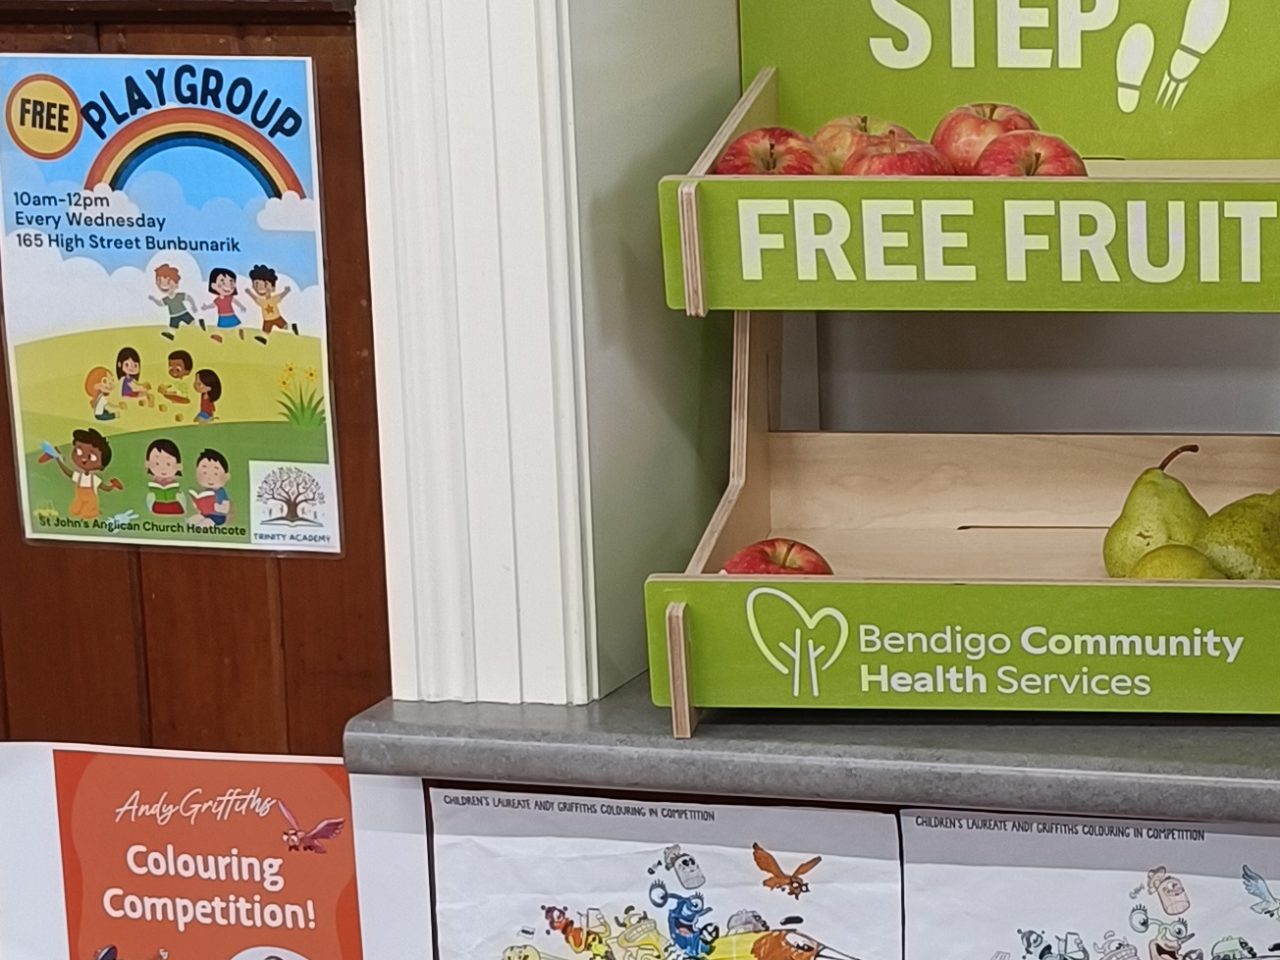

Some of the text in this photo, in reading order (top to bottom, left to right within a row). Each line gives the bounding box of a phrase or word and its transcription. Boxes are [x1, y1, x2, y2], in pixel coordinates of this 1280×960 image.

[19, 98, 70, 133] FREE
[79, 64, 302, 140] PLAYGROUP
[13, 191, 110, 211] 10am-12pm
[15, 211, 166, 232] Every Wednesday
[17, 233, 241, 252] 165 High Street Bunbunarik
[737, 199, 1279, 284] FREE FRUIT
[39, 516, 246, 536] St John's Anglican Church Heathcote
[254, 533, 331, 543] TRINITY ACADEMY
[858, 624, 1245, 663] Bendigo Community
[860, 664, 1152, 697] Health Services
[115, 787, 277, 825] Andy Griffiths
[443, 794, 489, 807] CHILDREN'S
[600, 803, 646, 817] COLOURING
[648, 807, 658, 817] IN
[661, 807, 715, 821] COMPETITION
[915, 815, 963, 829] CHILDREN'S
[966, 819, 1008, 831] LAUREATE
[1081, 824, 1130, 838] COLOURING
[1133, 827, 1143, 838] IN
[1146, 828, 1205, 841] COMPETITION
[126, 844, 285, 892] Colouring
[102, 887, 316, 932] Competition!
